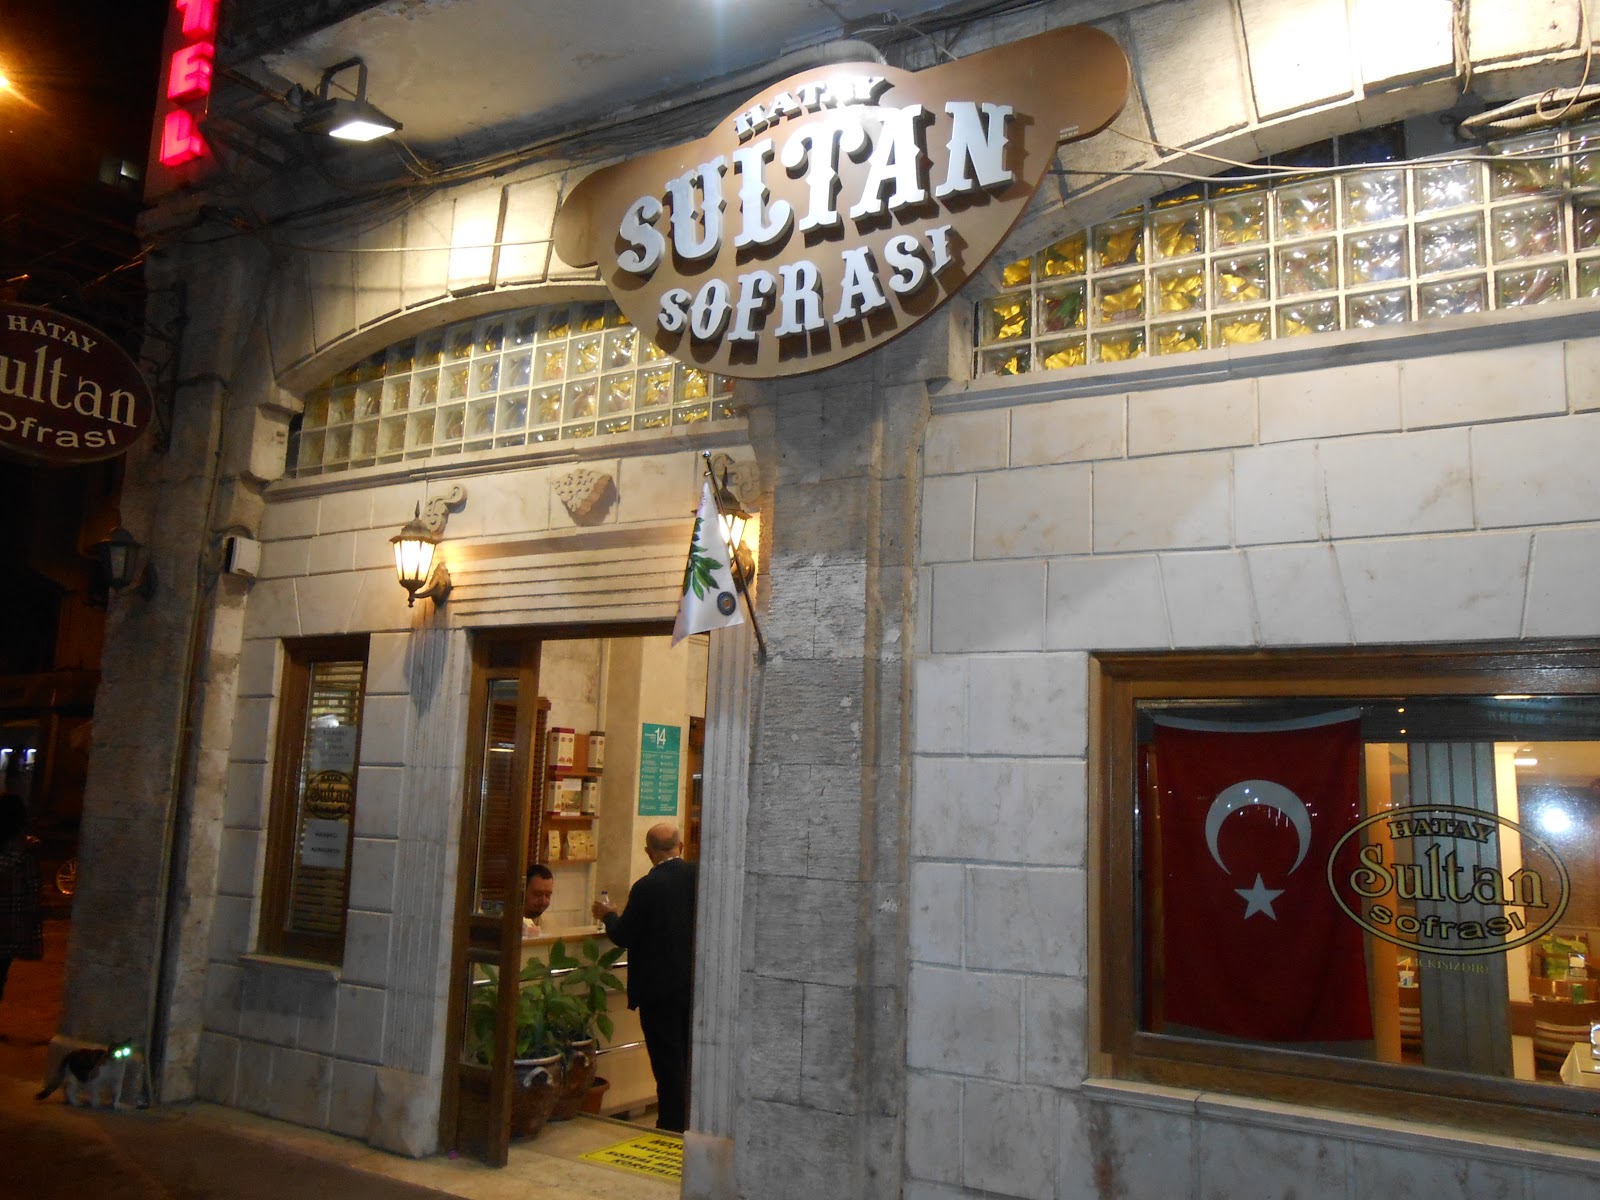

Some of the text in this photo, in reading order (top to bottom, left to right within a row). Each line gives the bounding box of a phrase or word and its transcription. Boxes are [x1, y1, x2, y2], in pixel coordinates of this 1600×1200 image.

[733, 75, 892, 139] HATAY
[616, 101, 1014, 276] SULTAN
[658, 224, 952, 343] SOFRASI
[7, 314, 98, 353] HATAY
[654, 727, 667, 746] 14
[1387, 817, 1496, 843] HATAY
[1350, 843, 1548, 908] Sultan
